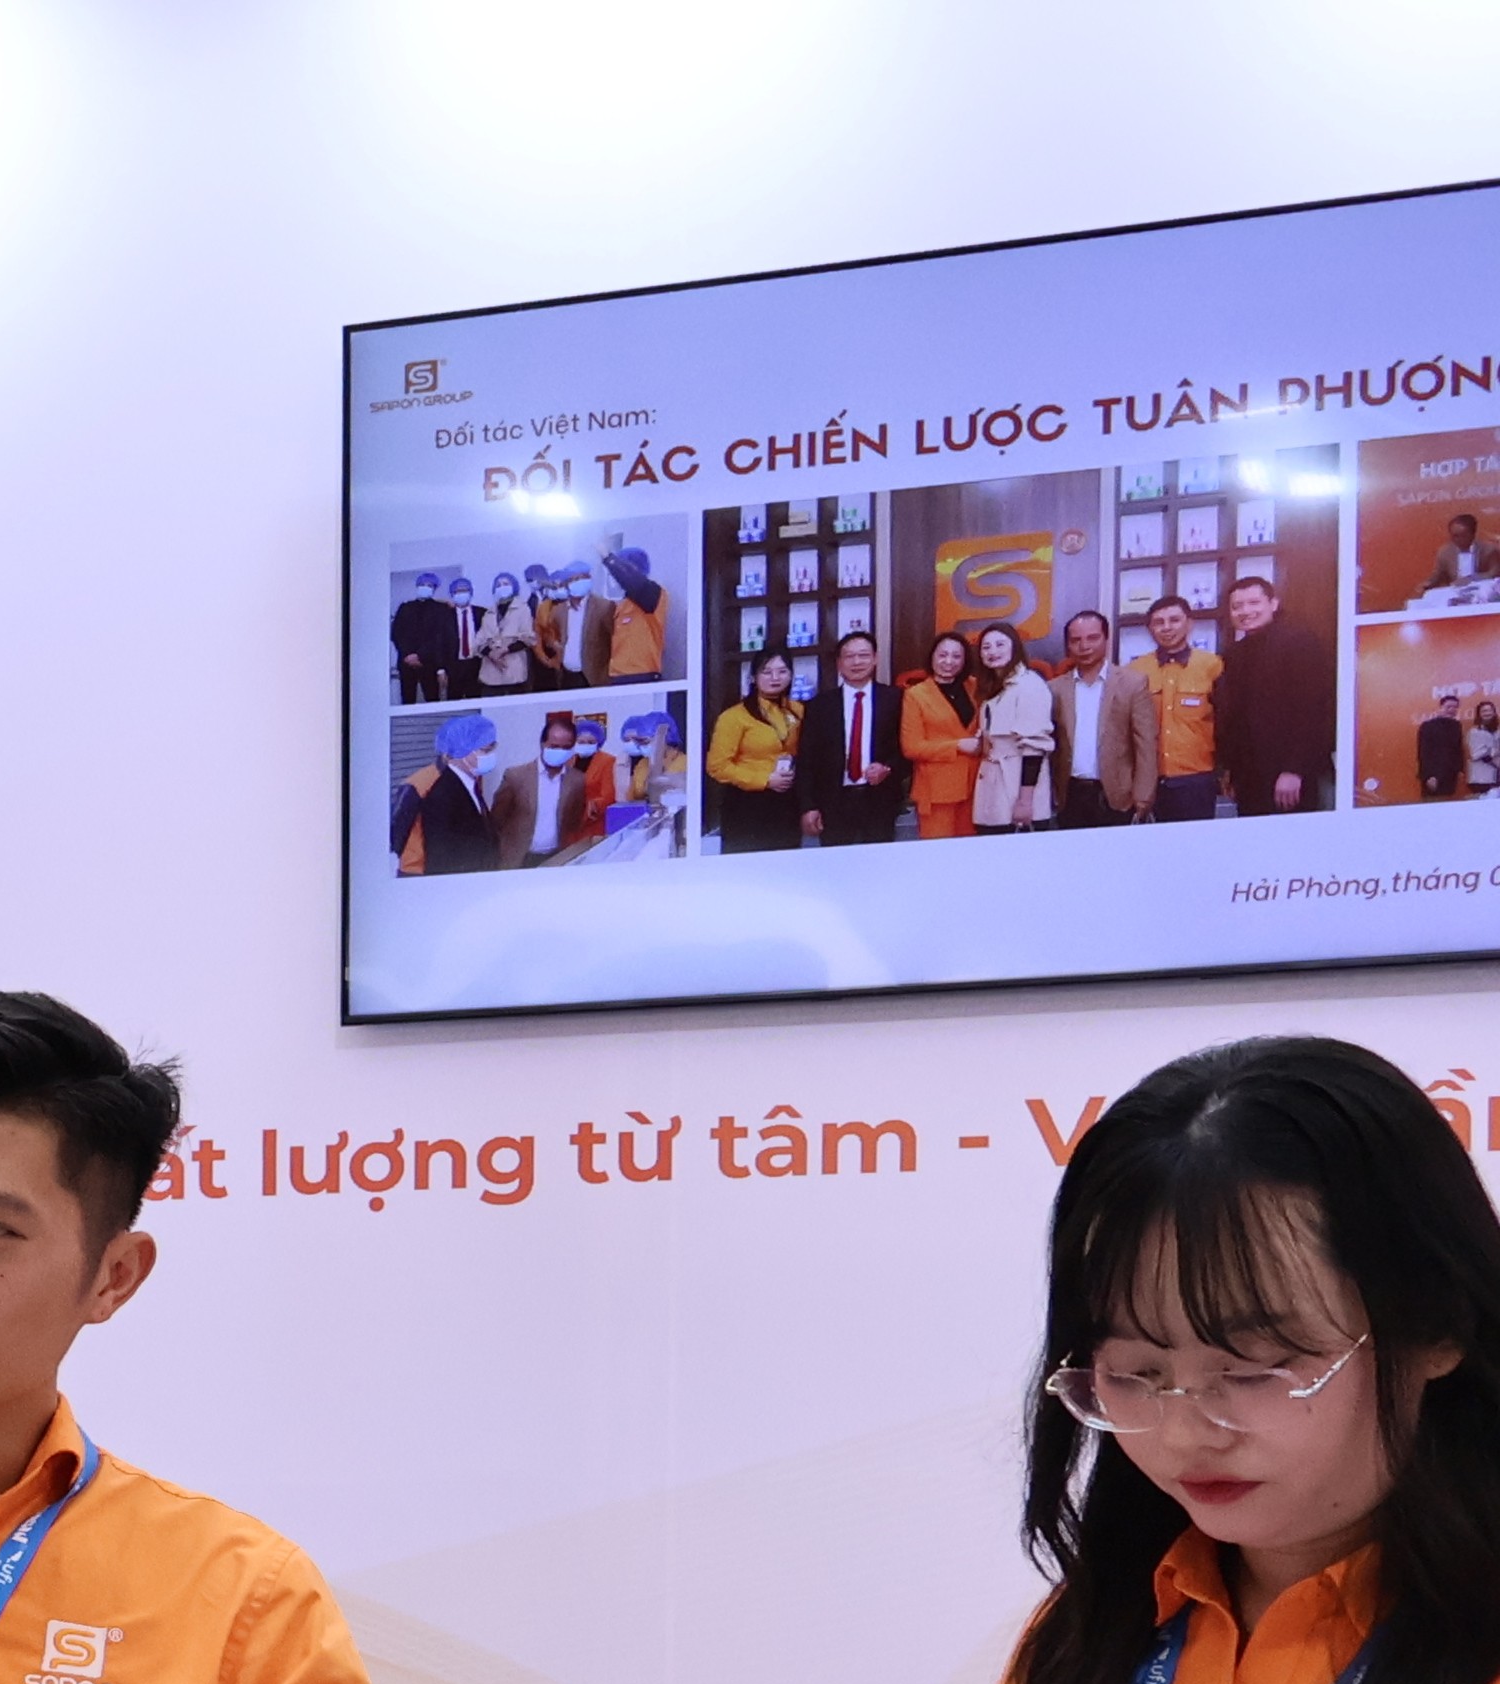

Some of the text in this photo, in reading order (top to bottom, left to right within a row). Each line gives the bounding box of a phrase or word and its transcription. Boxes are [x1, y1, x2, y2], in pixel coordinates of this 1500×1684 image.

[434, 408, 657, 449] Đối tác Việt Nam:
[594, 376, 1249, 489] TÁC CHIẾN LƯỢC TUÂN
[1231, 877, 1280, 904] Hải
[261, 1104, 920, 1213] lượng từ tâm
